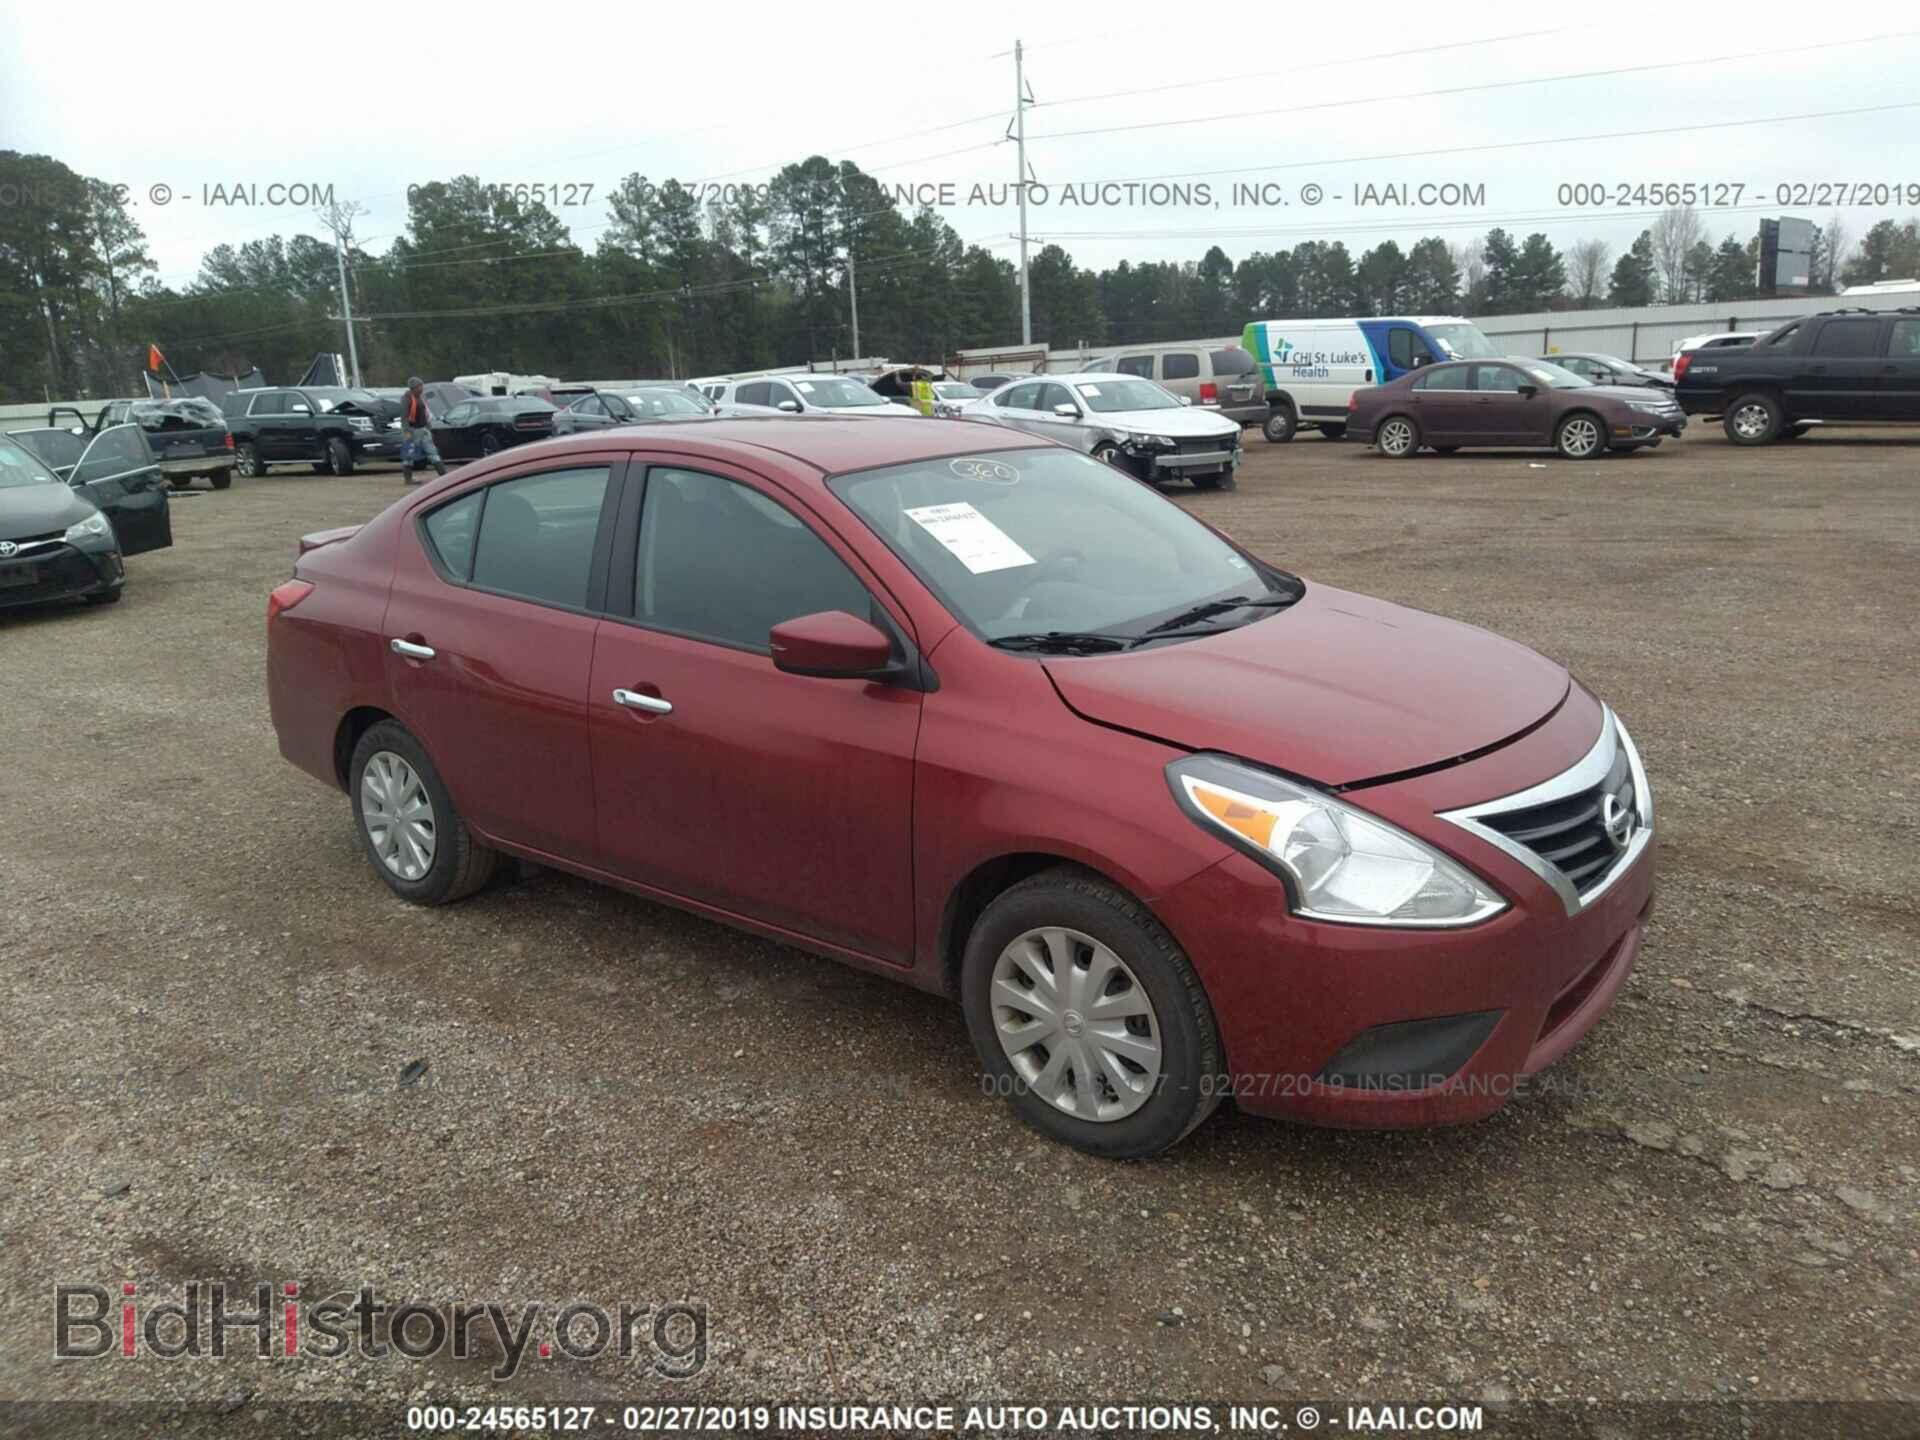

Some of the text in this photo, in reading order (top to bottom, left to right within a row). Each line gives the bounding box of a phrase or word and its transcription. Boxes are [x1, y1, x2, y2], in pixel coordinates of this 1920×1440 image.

[1293, 351, 1367, 364] CHI St. Luke's
[1293, 366, 1329, 378] Health
